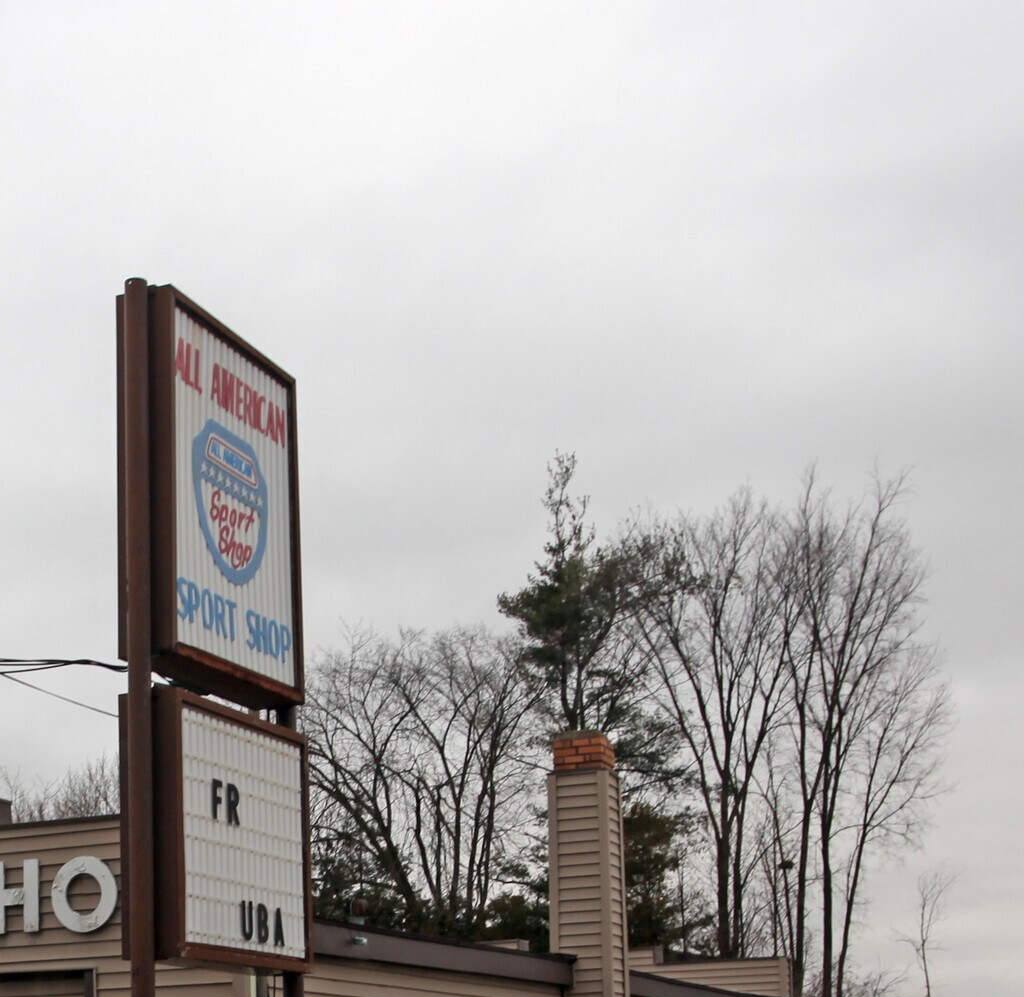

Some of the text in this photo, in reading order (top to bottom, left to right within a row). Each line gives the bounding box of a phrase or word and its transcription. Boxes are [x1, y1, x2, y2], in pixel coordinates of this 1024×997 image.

[175, 337, 285, 448] ALL AMERICAN
[210, 490, 255, 533] Sport
[218, 525, 252, 569] Shop
[176, 576, 291, 664] SPORT SHOP
[211, 778, 240, 826] FR
[240, 900, 285, 947] UBA
